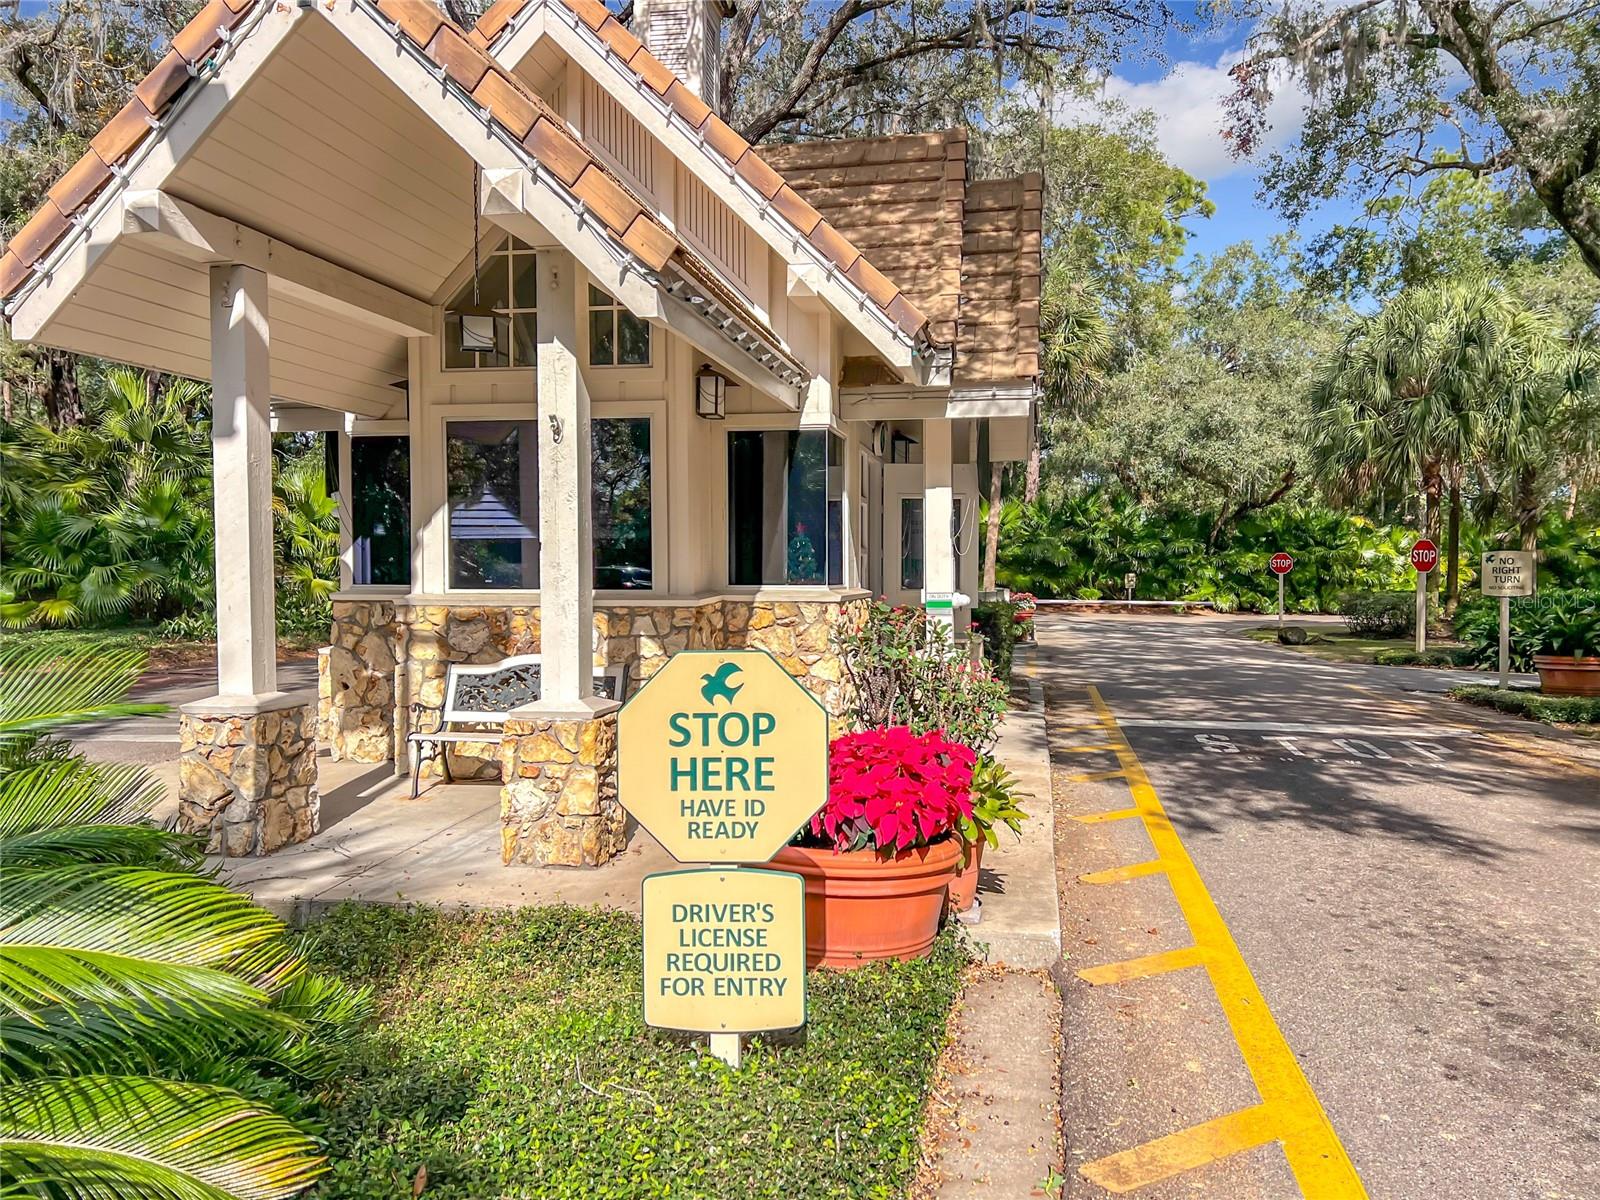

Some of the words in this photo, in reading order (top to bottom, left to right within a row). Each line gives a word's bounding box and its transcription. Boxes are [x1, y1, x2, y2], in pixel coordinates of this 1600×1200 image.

[1271, 559, 1292, 568] STOP
[1412, 549, 1436, 563] STOP
[1492, 566, 1521, 574] RIGHT
[1493, 575, 1521, 583] TURN
[668, 711, 776, 748] STOP
[1193, 733, 1455, 762] STOP
[670, 756, 775, 792] HERE
[680, 799, 736, 817] HAVE
[744, 799, 766, 817] ID
[688, 821, 759, 839] READY
[672, 902, 775, 923] DRIVER'S
[679, 928, 768, 948] LICENSE
[666, 953, 782, 975] REQUIRED
[660, 977, 705, 996] FOR
[714, 977, 788, 996] ENTRY
